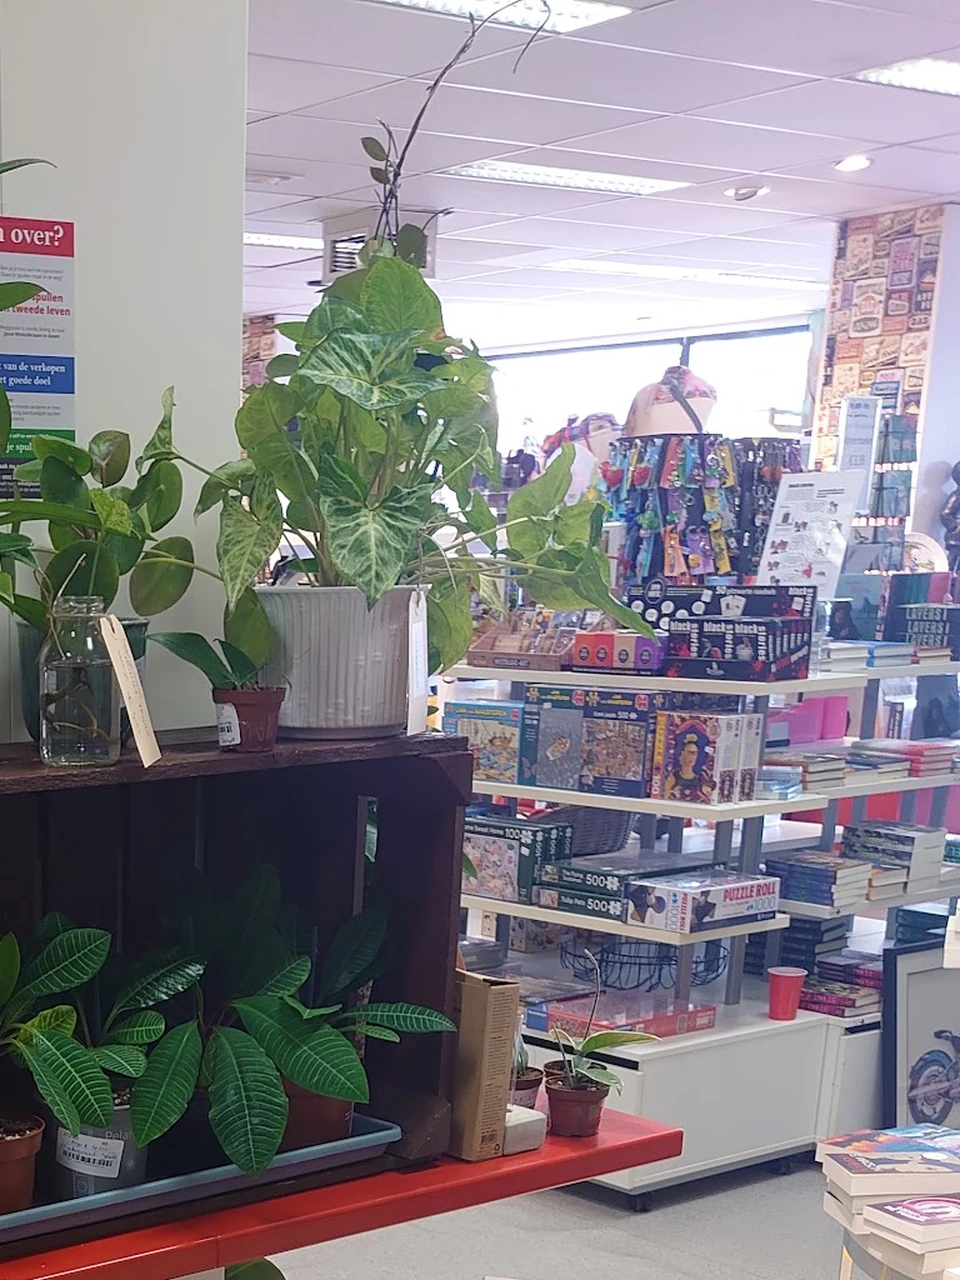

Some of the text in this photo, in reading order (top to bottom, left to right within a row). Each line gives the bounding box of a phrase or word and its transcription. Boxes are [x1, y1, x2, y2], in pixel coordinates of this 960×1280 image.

[10, 225, 64, 247] over?
[12, 306, 44, 316] tweede
[46, 305, 71, 316] leven
[4, 363, 17, 371] van
[19, 362, 28, 371] de
[30, 363, 66, 375] verkopen
[8, 377, 33, 386] goede
[33, 376, 51, 385] doel
[6, 442, 14, 453] je
[715, 585, 727, 595] 50
[906, 608, 942, 620] LAYERS
[907, 621, 942, 634] LAYERS
[906, 634, 942, 646] LAYERS
[505, 828, 520, 839] 100
[585, 873, 606, 887] 500
[723, 882, 776, 902] PUZZLE ROLL
[586, 898, 608, 912] 500
[754, 896, 776, 911] 1000
[679, 892, 688, 931] PUZZLE ROLL
